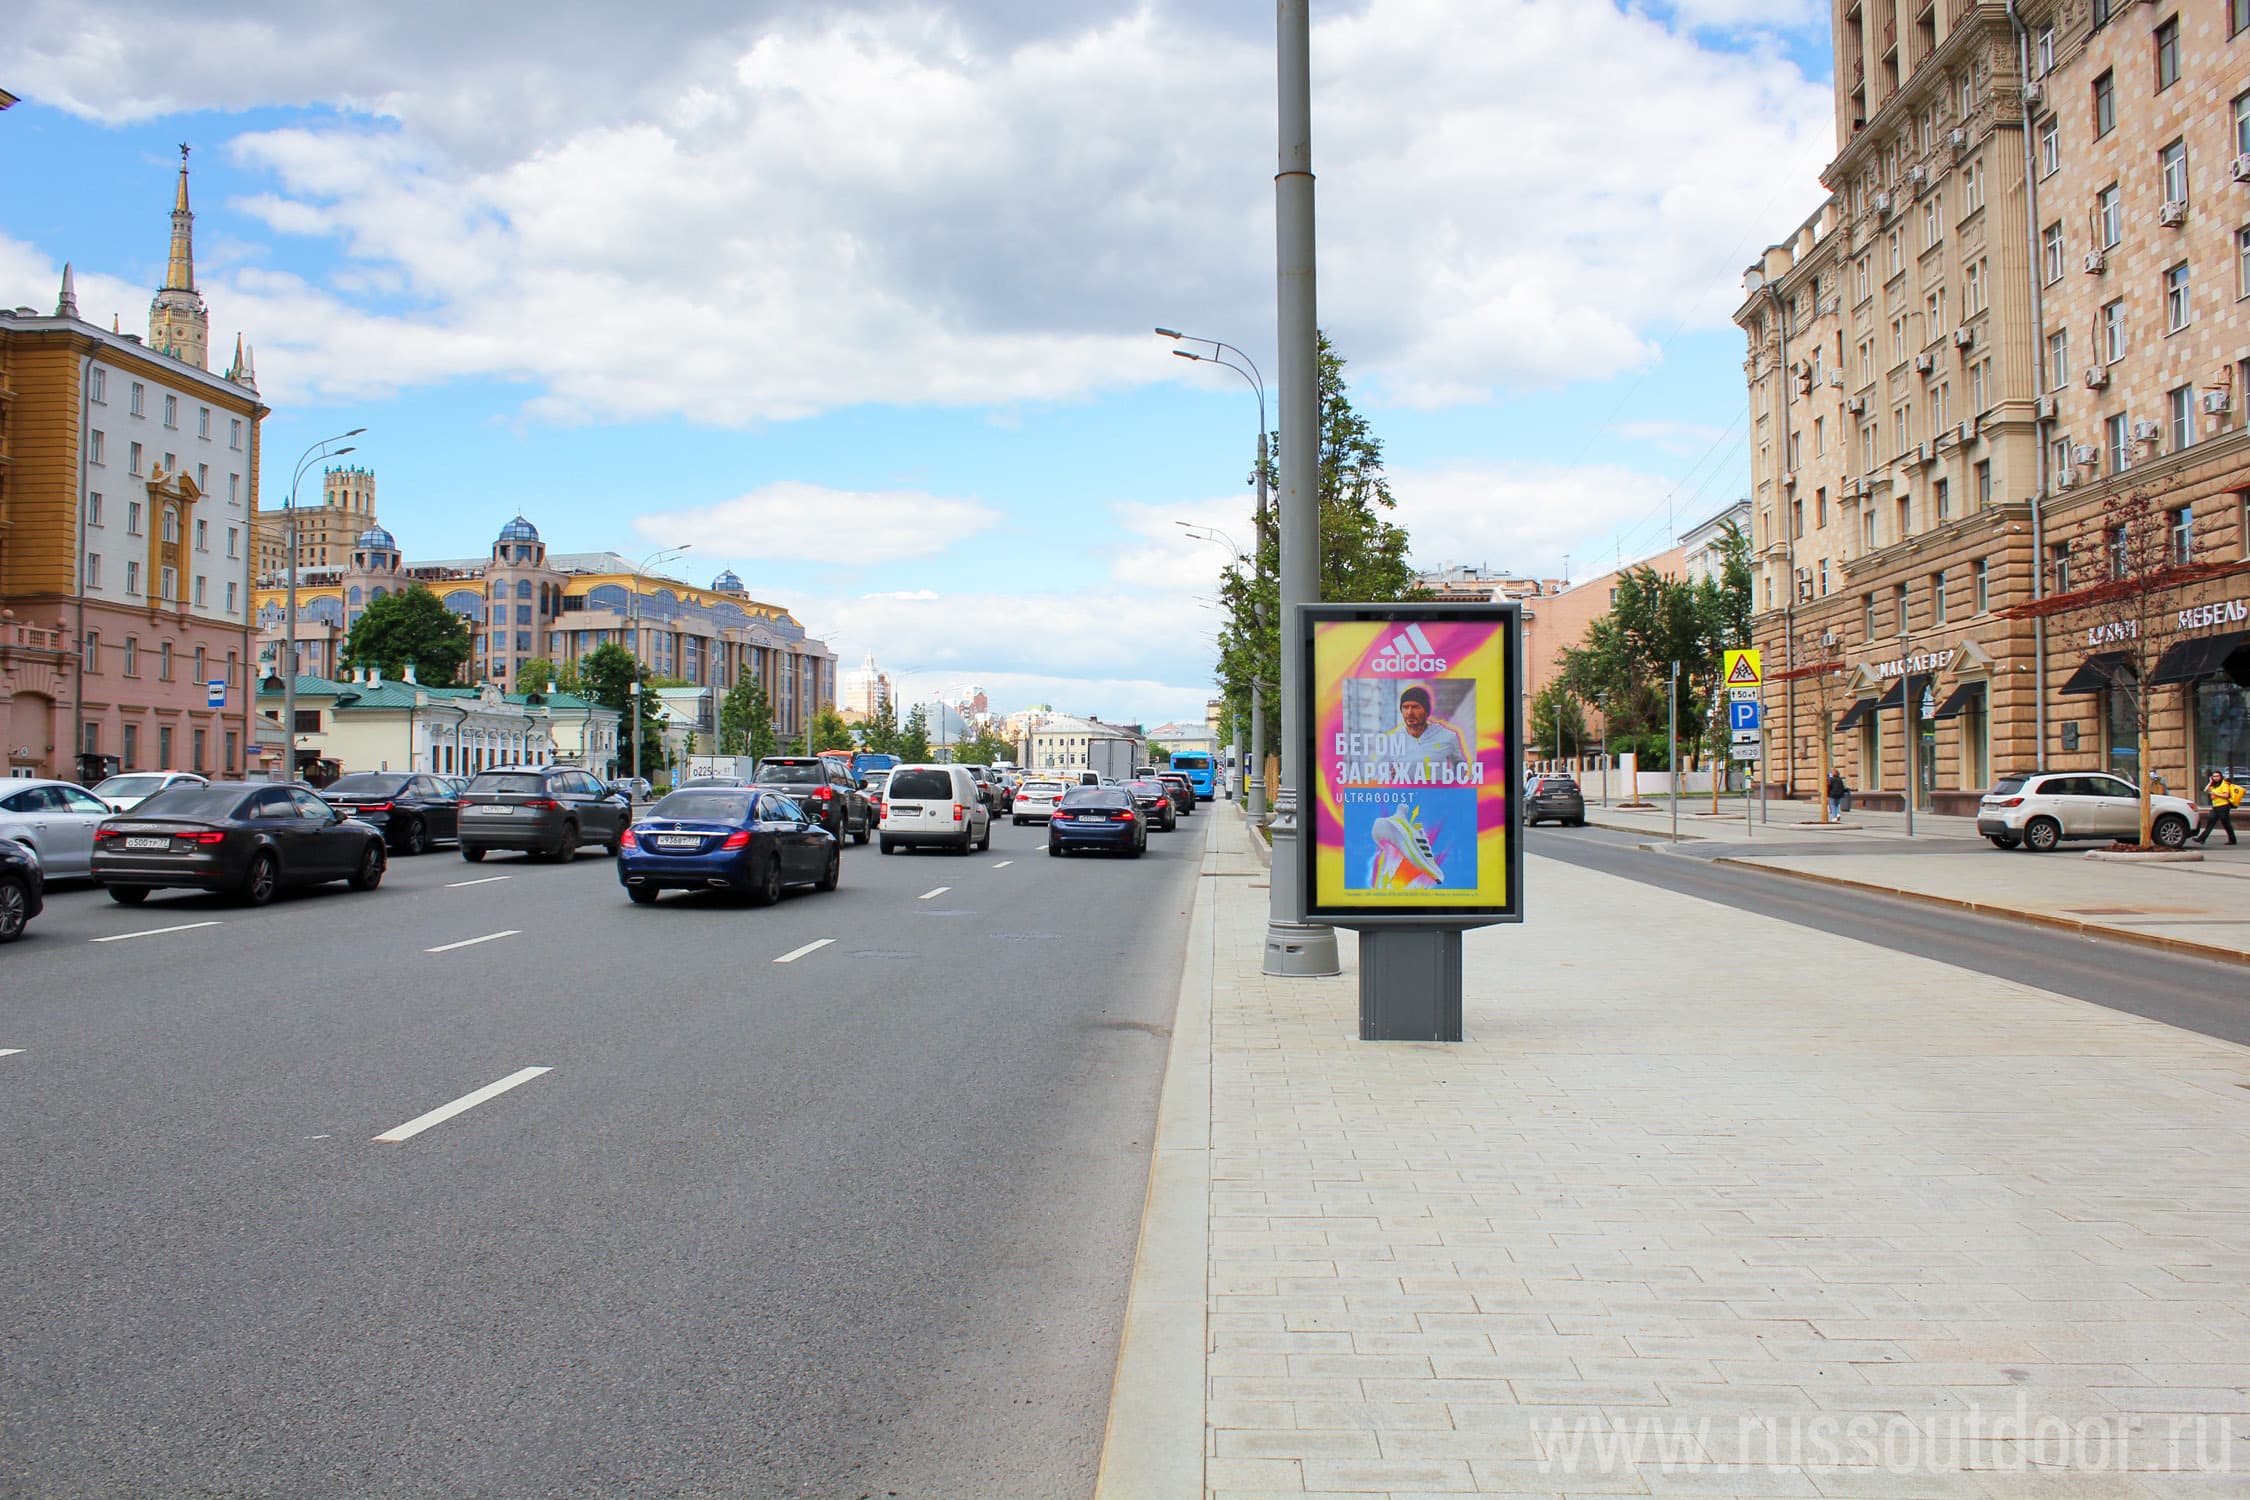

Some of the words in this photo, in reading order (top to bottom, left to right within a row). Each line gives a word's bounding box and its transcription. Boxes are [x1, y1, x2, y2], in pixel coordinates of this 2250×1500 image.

[2178, 599, 2249, 630] МЕБЕЛЬ
[1371, 654, 1448, 673] adidas
[1738, 705, 1754, 728] P
[1335, 732, 1407, 756] БЕГОМ
[1336, 761, 1485, 785] ЗАРЯЖАТЬСЯ
[1336, 792, 1414, 803] ULTRABOOST
